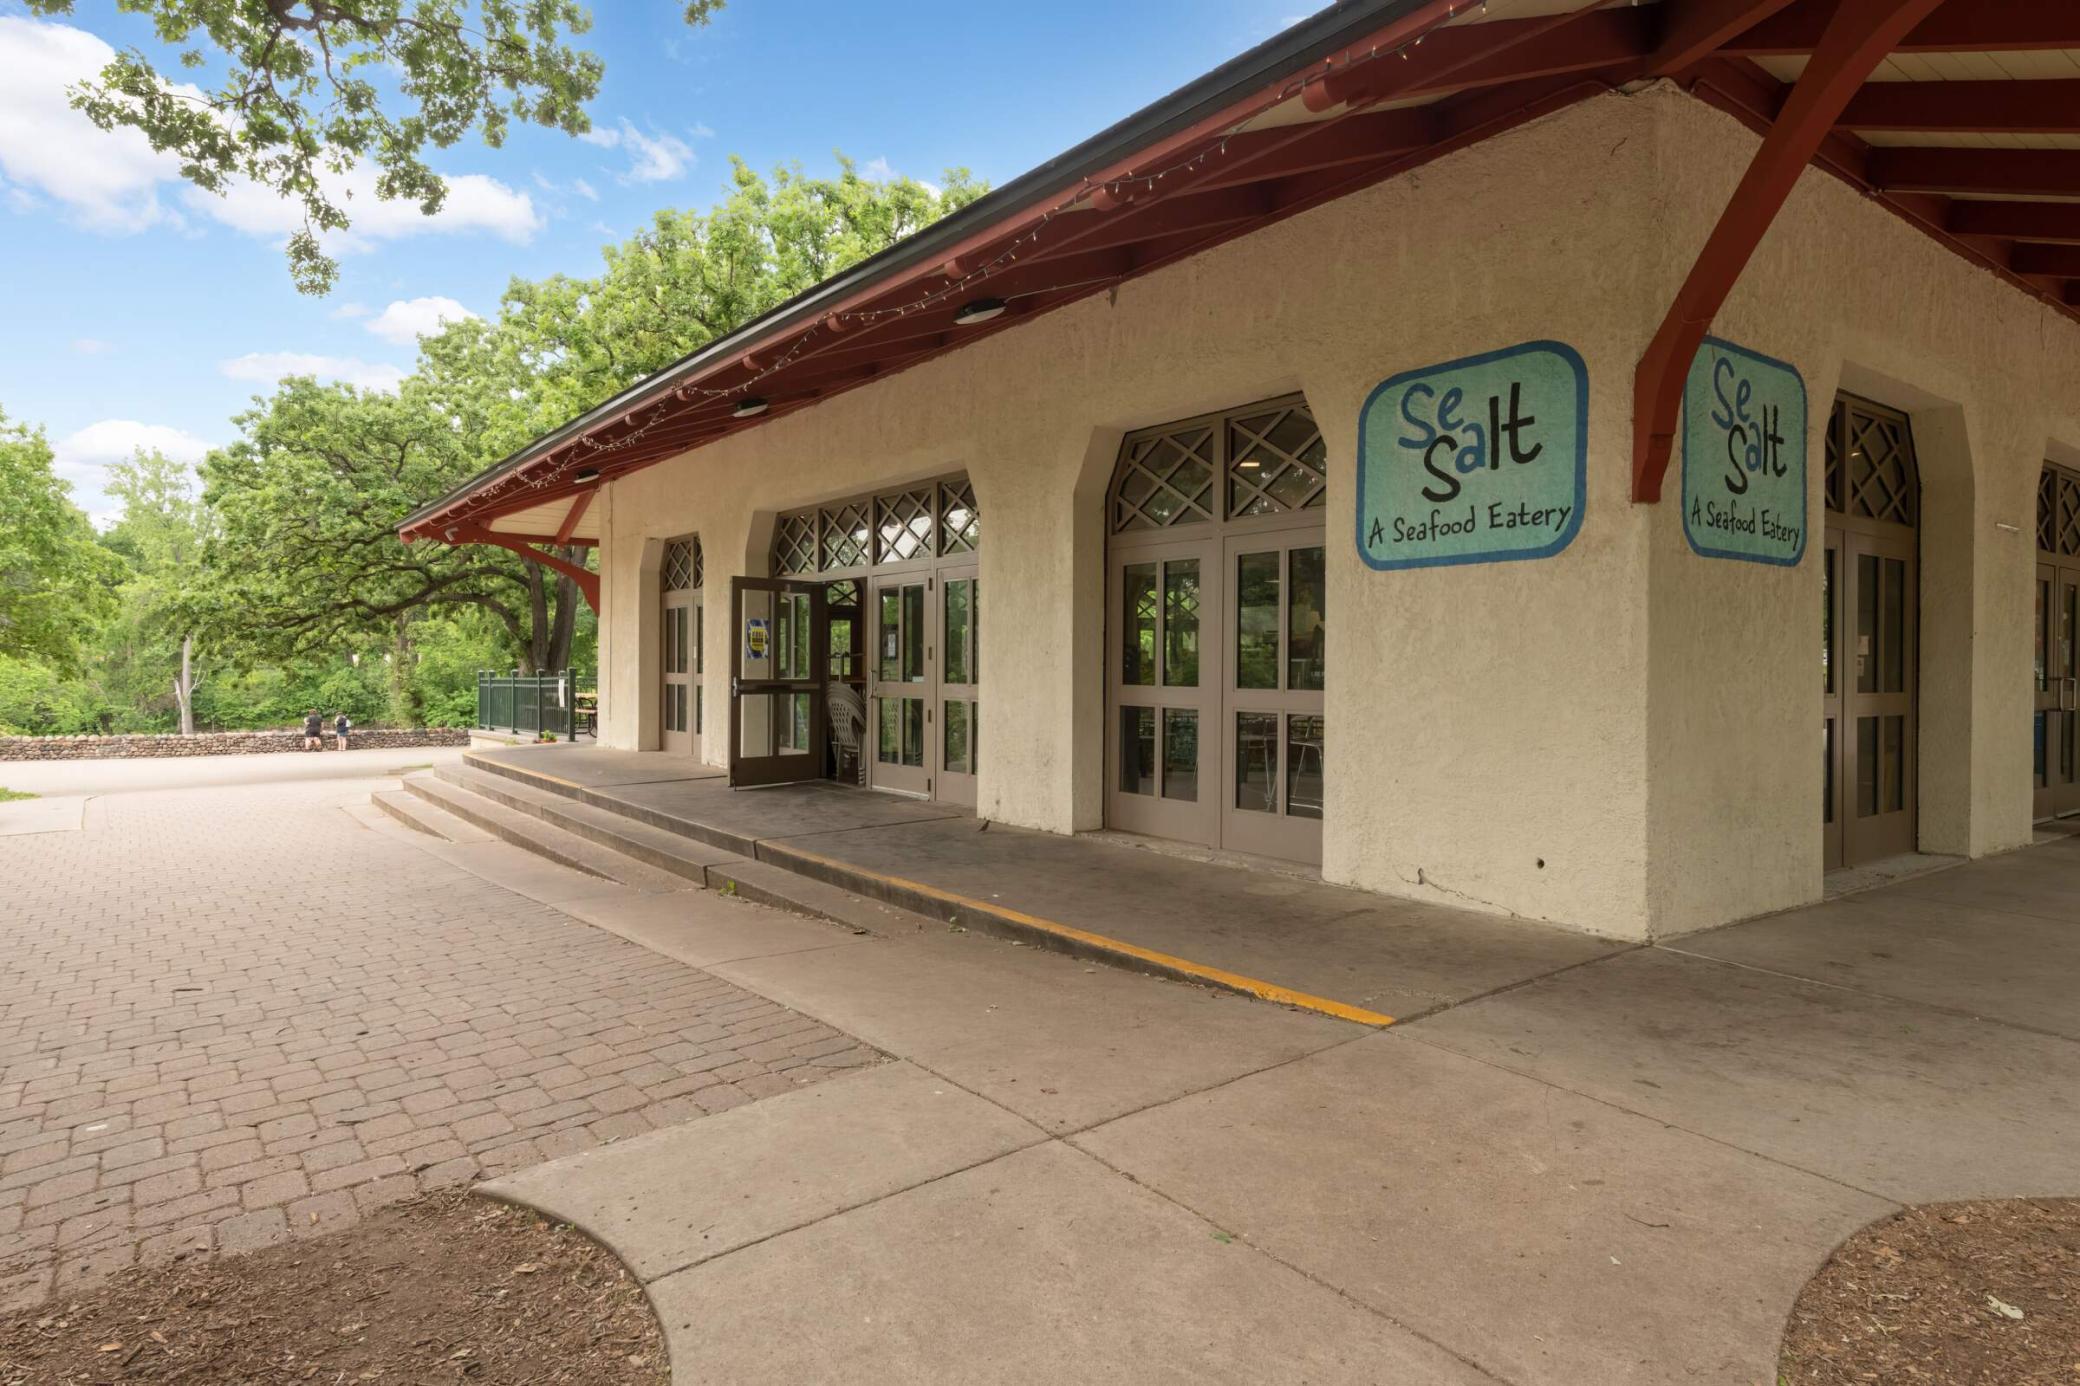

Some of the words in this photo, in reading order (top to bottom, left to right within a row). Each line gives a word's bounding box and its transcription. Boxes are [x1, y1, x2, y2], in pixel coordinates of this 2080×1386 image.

[1398, 382, 1486, 474] Sea
[1421, 382, 1543, 502] Salt
[1711, 357, 1762, 472] Sea
[1724, 405, 1787, 495] Salt
[1368, 516, 1385, 549] A
[1393, 505, 1476, 543] Seafood
[1488, 502, 1571, 532] Eatery
[1691, 494, 1702, 526] A
[1707, 499, 1756, 535] Seafood
[1761, 509, 1800, 550] Eatery
